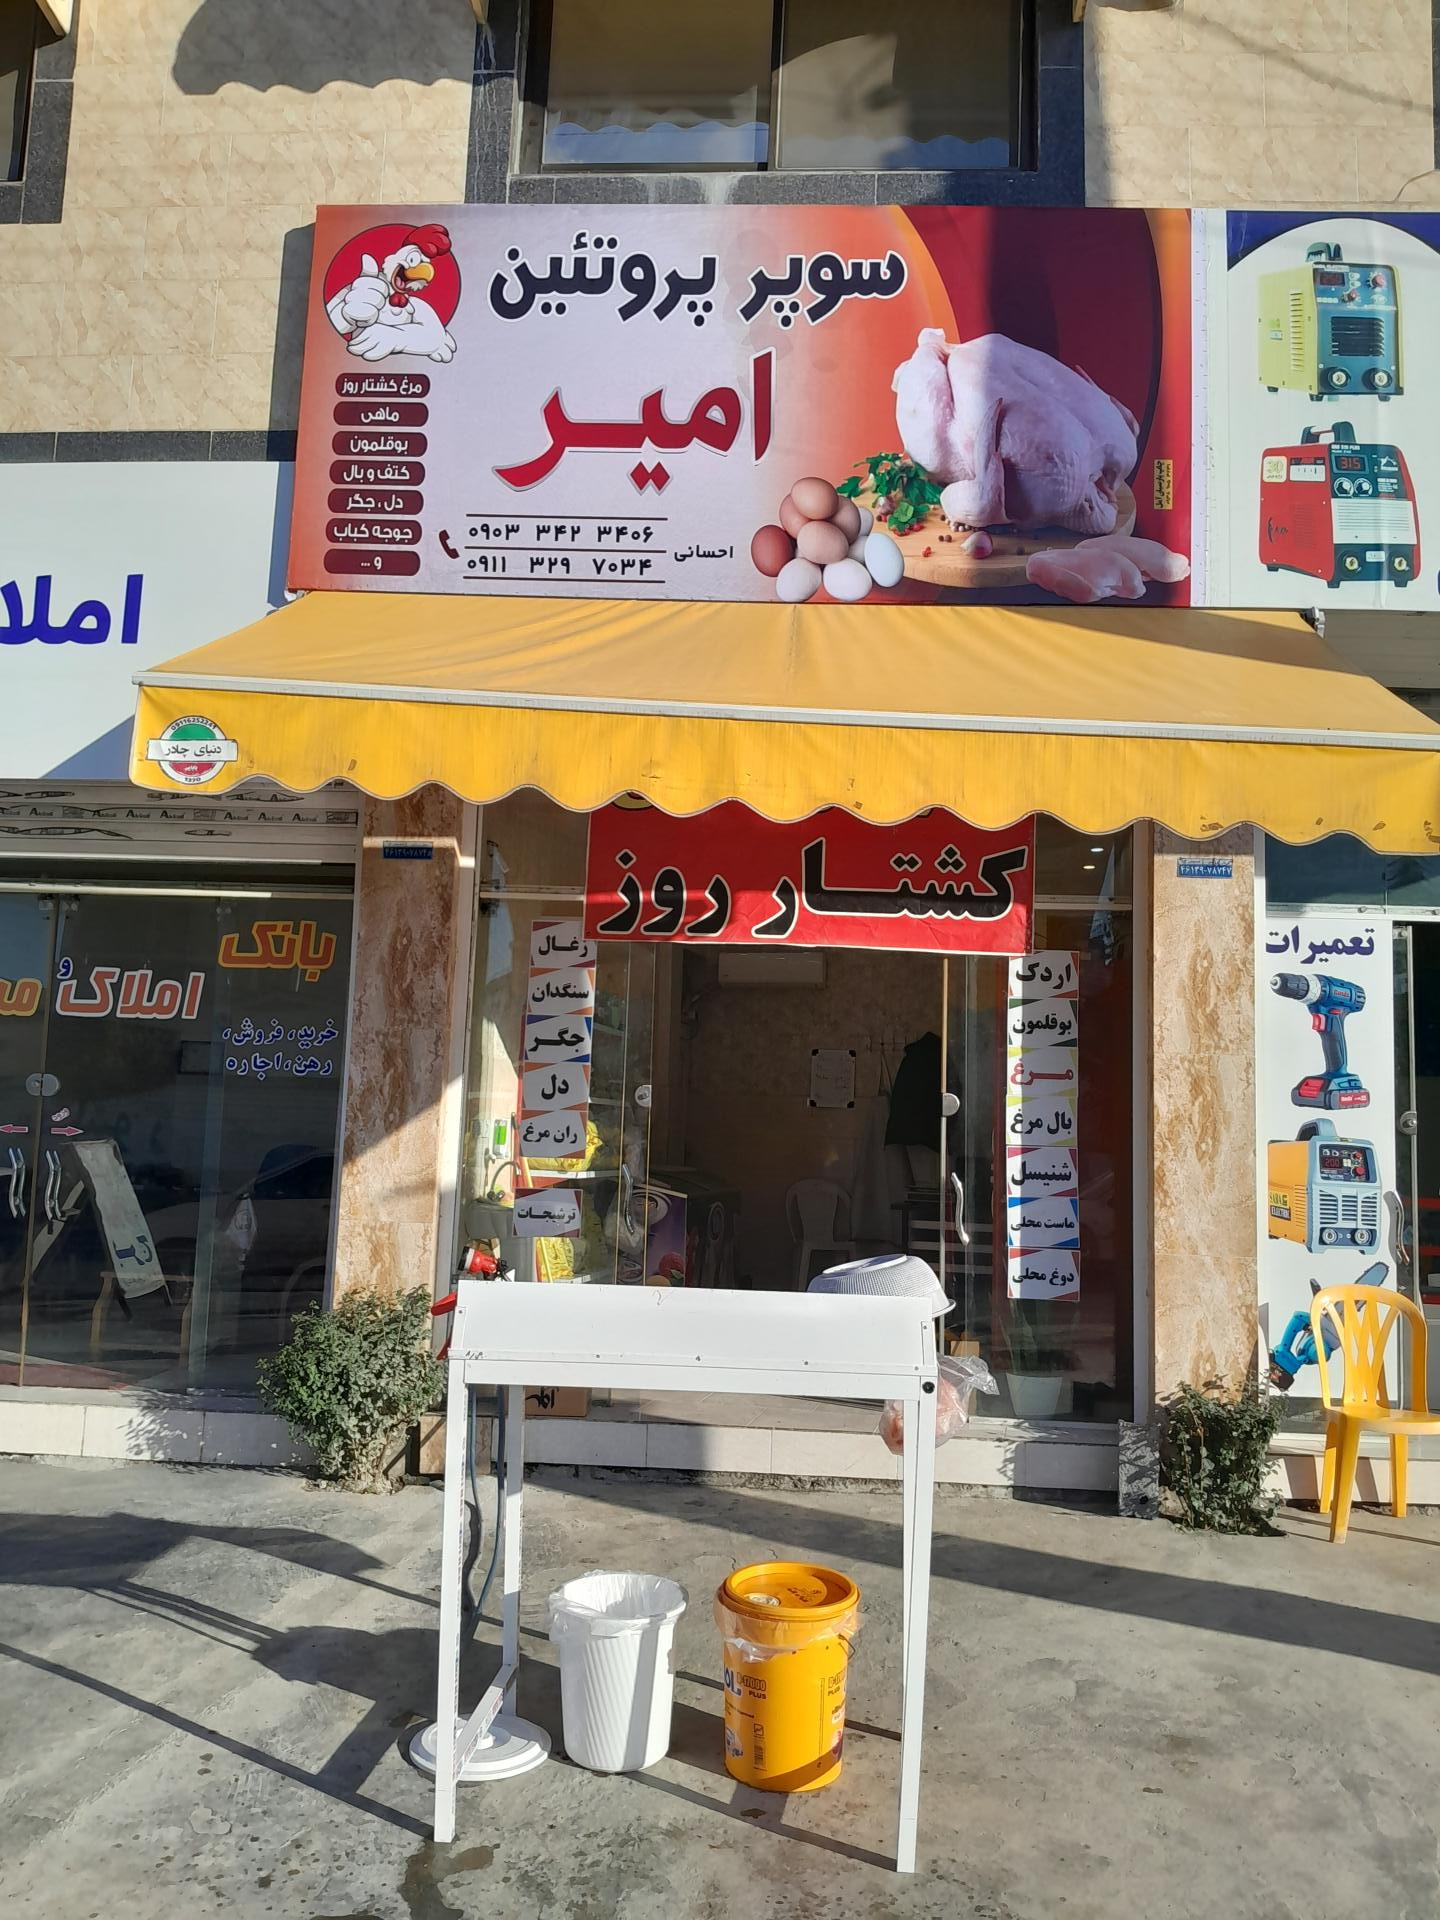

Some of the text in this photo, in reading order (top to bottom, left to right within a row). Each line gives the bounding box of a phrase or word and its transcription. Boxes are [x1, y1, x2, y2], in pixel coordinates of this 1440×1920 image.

[490, 231, 906, 327] سوپر پروتئین
[341, 376, 422, 395] مرغ کشتار روز
[360, 406, 400, 423] ماهی
[491, 348, 776, 494] امیر
[350, 435, 408, 455] بوقلمون
[343, 463, 410, 483] کتف و بال
[346, 493, 376, 512] جگر
[333, 523, 413, 543] جوجه کباب
[468, 523, 654, 543] ۰۹۰۳ ۳۴۲ ۳۴۰۶
[674, 545, 734, 562] احسانی
[467, 555, 652, 575] ۰۹۱۱ ۳۲۹ ۷۰۳۴
[193, 744, 222, 757] دنیای
[597, 838, 1029, 939] کشتار روز
[217, 920, 338, 982] بانک
[1265, 925, 1375, 964] تعمیرات
[56, 956, 74, 980] و
[1015, 962, 1071, 990] اردک
[55, 966, 205, 1020] املاک
[532, 982, 589, 1002] سنگدان
[1012, 1013, 1072, 1036] بوقلمون
[528, 1027, 585, 1053] جگر
[1010, 1057, 1074, 1086] مرغ
[541, 1073, 570, 1101] دل
[1010, 1108, 1073, 1135] بال مرغ
[522, 1122, 578, 1144] ران مرغ
[1010, 1161, 1072, 1186] شنیسل
[1010, 1216, 1075, 1231] ماست محلی
[1012, 1267, 1075, 1287] دوغ محلی
